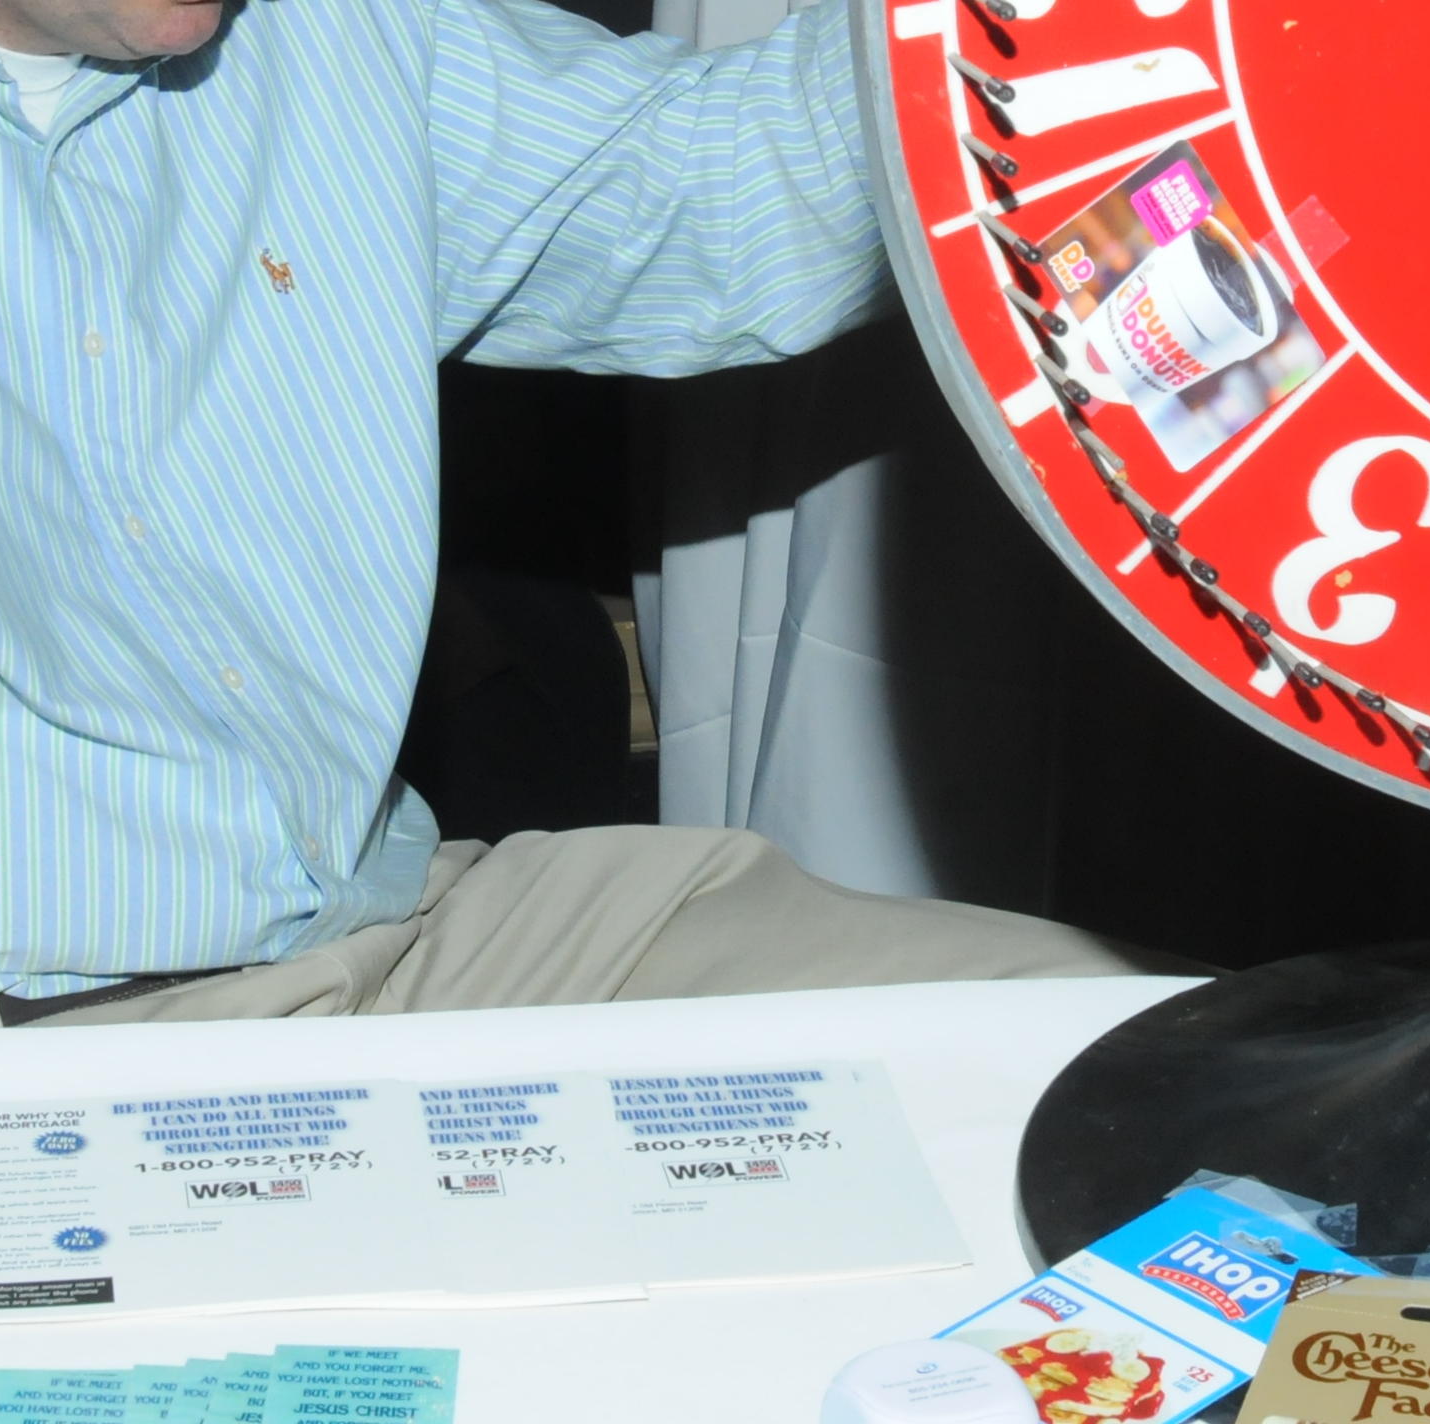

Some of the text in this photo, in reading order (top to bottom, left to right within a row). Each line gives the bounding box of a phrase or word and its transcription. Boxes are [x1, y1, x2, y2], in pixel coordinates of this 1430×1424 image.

[1060, 240, 1096, 283] DD
[1122, 310, 1193, 388] DONUTS
[142, 1088, 369, 1112] BLESSED AND REMEMBER
[457, 1083, 559, 1100] REMEMBER
[271, 1105, 336, 1119] THINGS
[236, 1119, 347, 1137] CHRIST WHO
[164, 1137, 293, 1155] STRENGTHENS
[135, 1150, 366, 1174] 1-800-952-PRAY
[667, 1162, 746, 1180] WOL
[189, 1181, 269, 1199] WOL
[1170, 1239, 1281, 1301] IHOP
[1031, 1286, 1079, 1315] IHOP
[1151, 1266, 1240, 1318] RESTAURANT
[1368, 1333, 1416, 1355] The
[355, 1363, 405, 1374] FORGET
[1186, 1365, 1215, 1383] $25
[306, 1375, 378, 1387] HAVE LOST
[294, 1403, 419, 1419] JESUS CHRIST
